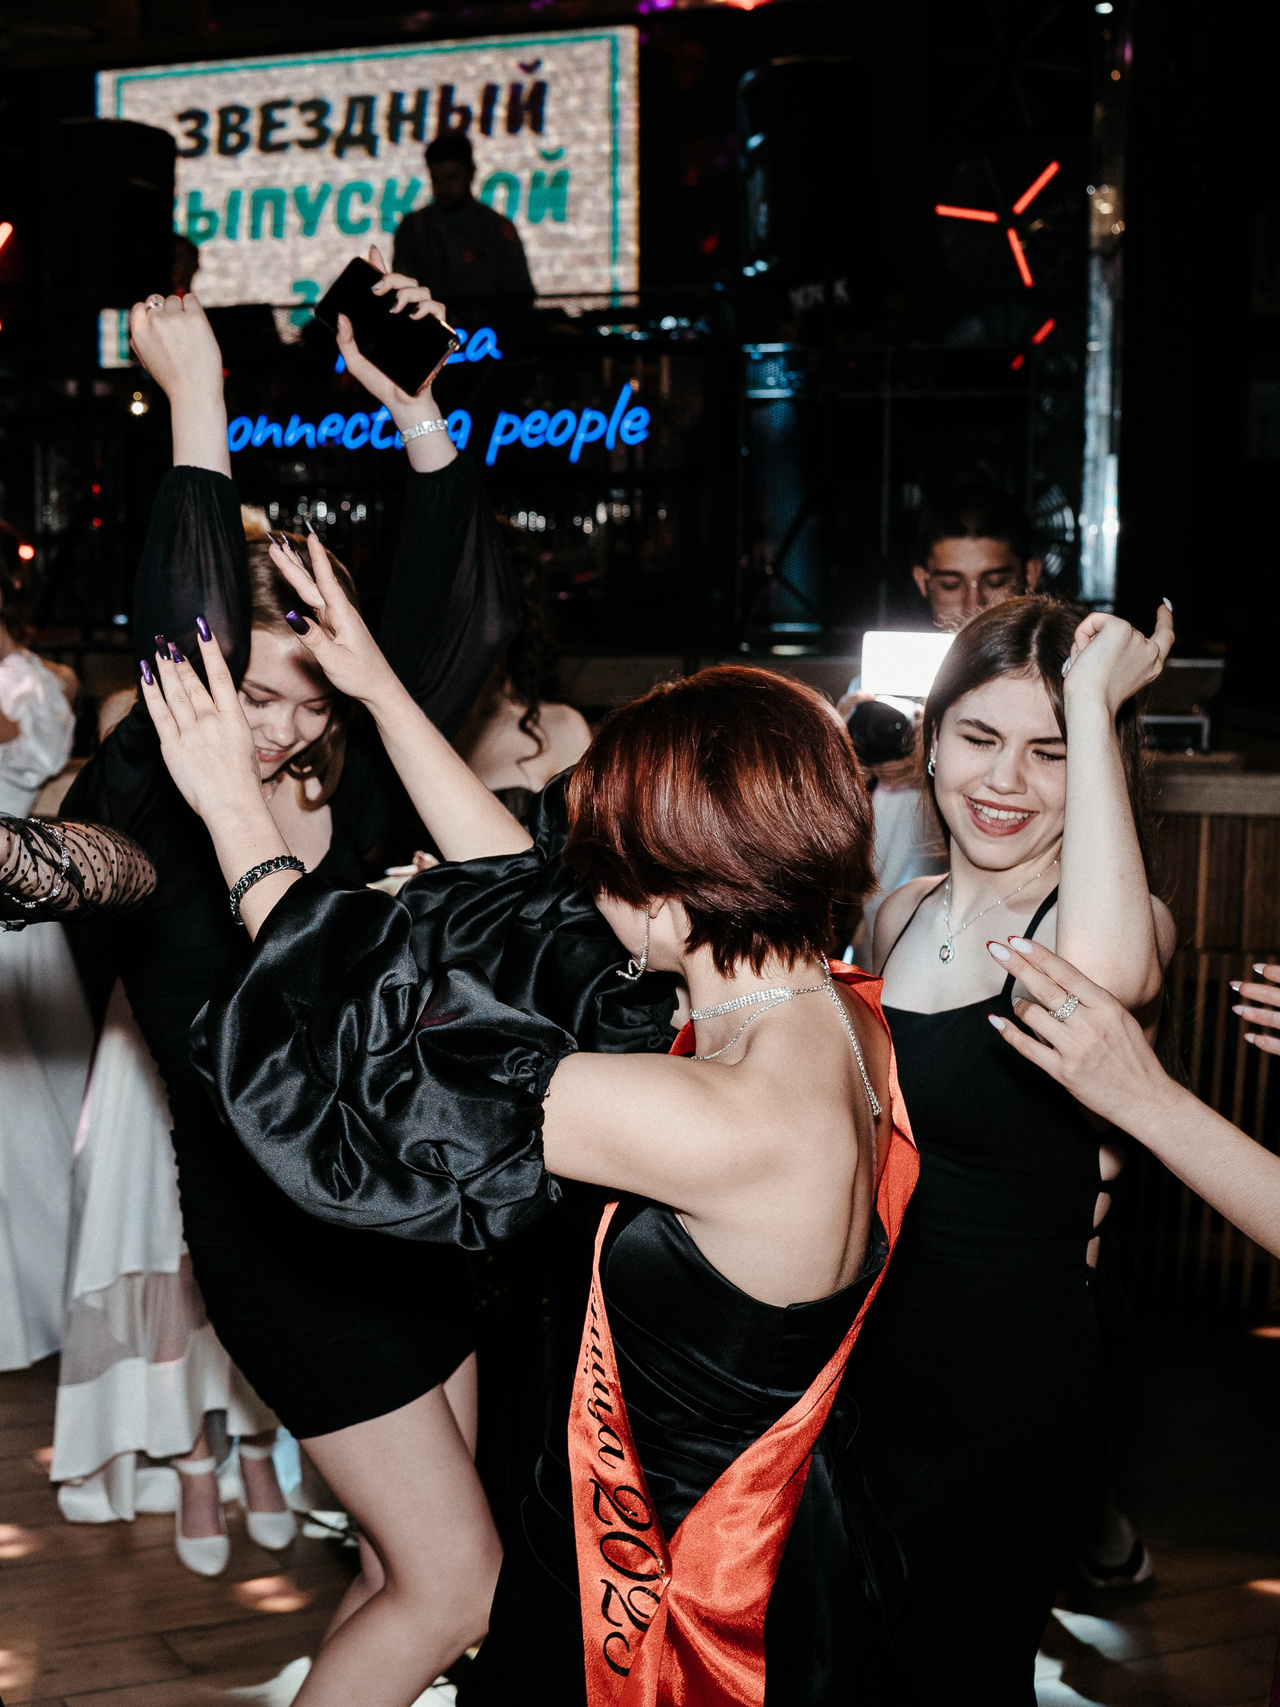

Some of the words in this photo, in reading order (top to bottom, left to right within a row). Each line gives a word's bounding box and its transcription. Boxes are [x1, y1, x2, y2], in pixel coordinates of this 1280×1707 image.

[176, 59, 548, 158] ЗВЕЗДНЫЙ
[174, 147, 569, 244] ЫПУСКОЙ
[227, 405, 472, 452] onnect
[485, 383, 650, 466] people
